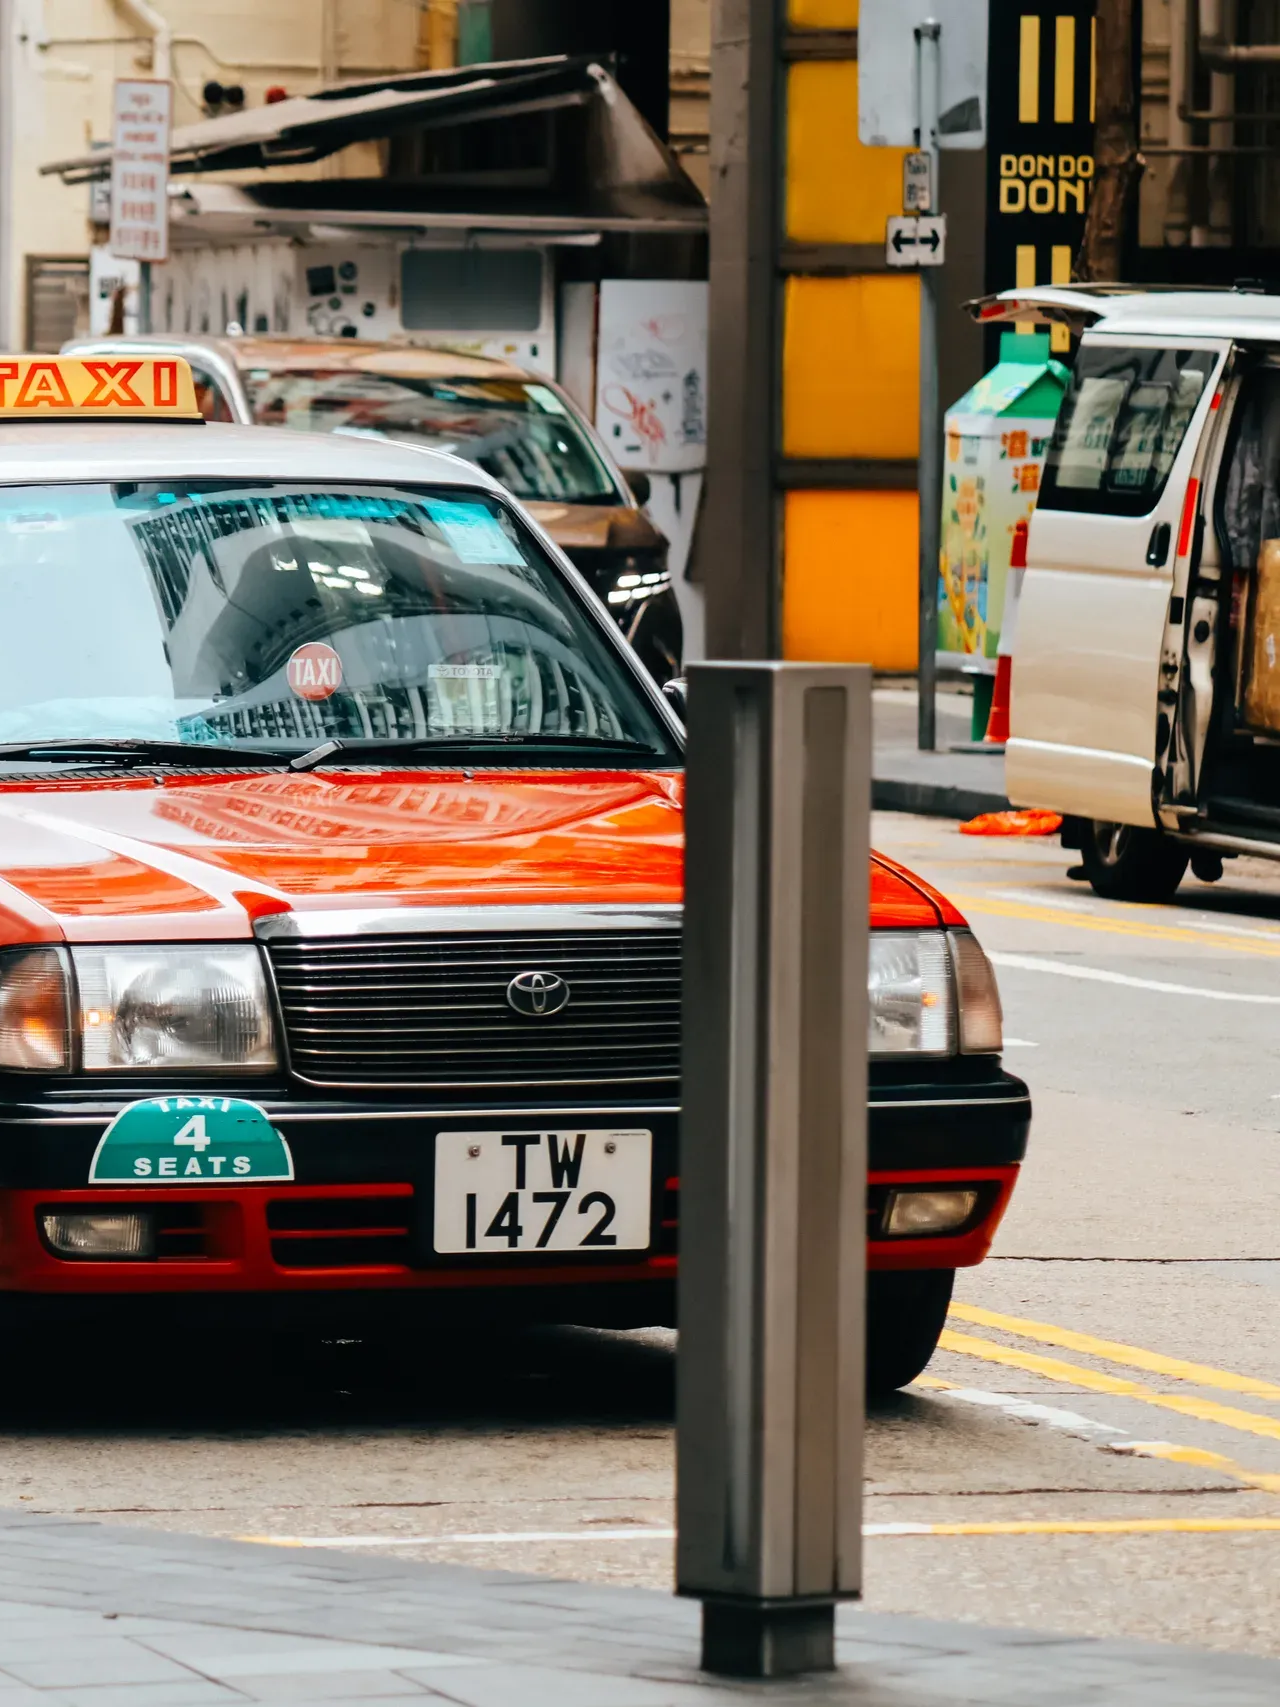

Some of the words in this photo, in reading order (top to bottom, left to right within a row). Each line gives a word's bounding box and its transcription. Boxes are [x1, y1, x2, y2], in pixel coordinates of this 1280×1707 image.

[1000, 154, 1055, 178] DON
[1058, 154, 1095, 178] DO
[999, 178, 1093, 214] DON
[291, 658, 337, 686] TAXI
[151, 1097, 231, 1113] TAXI
[173, 1115, 211, 1152] 4
[133, 1156, 252, 1176] SEATS
[501, 1134, 587, 1190] TW
[466, 1191, 617, 1249] 1472
